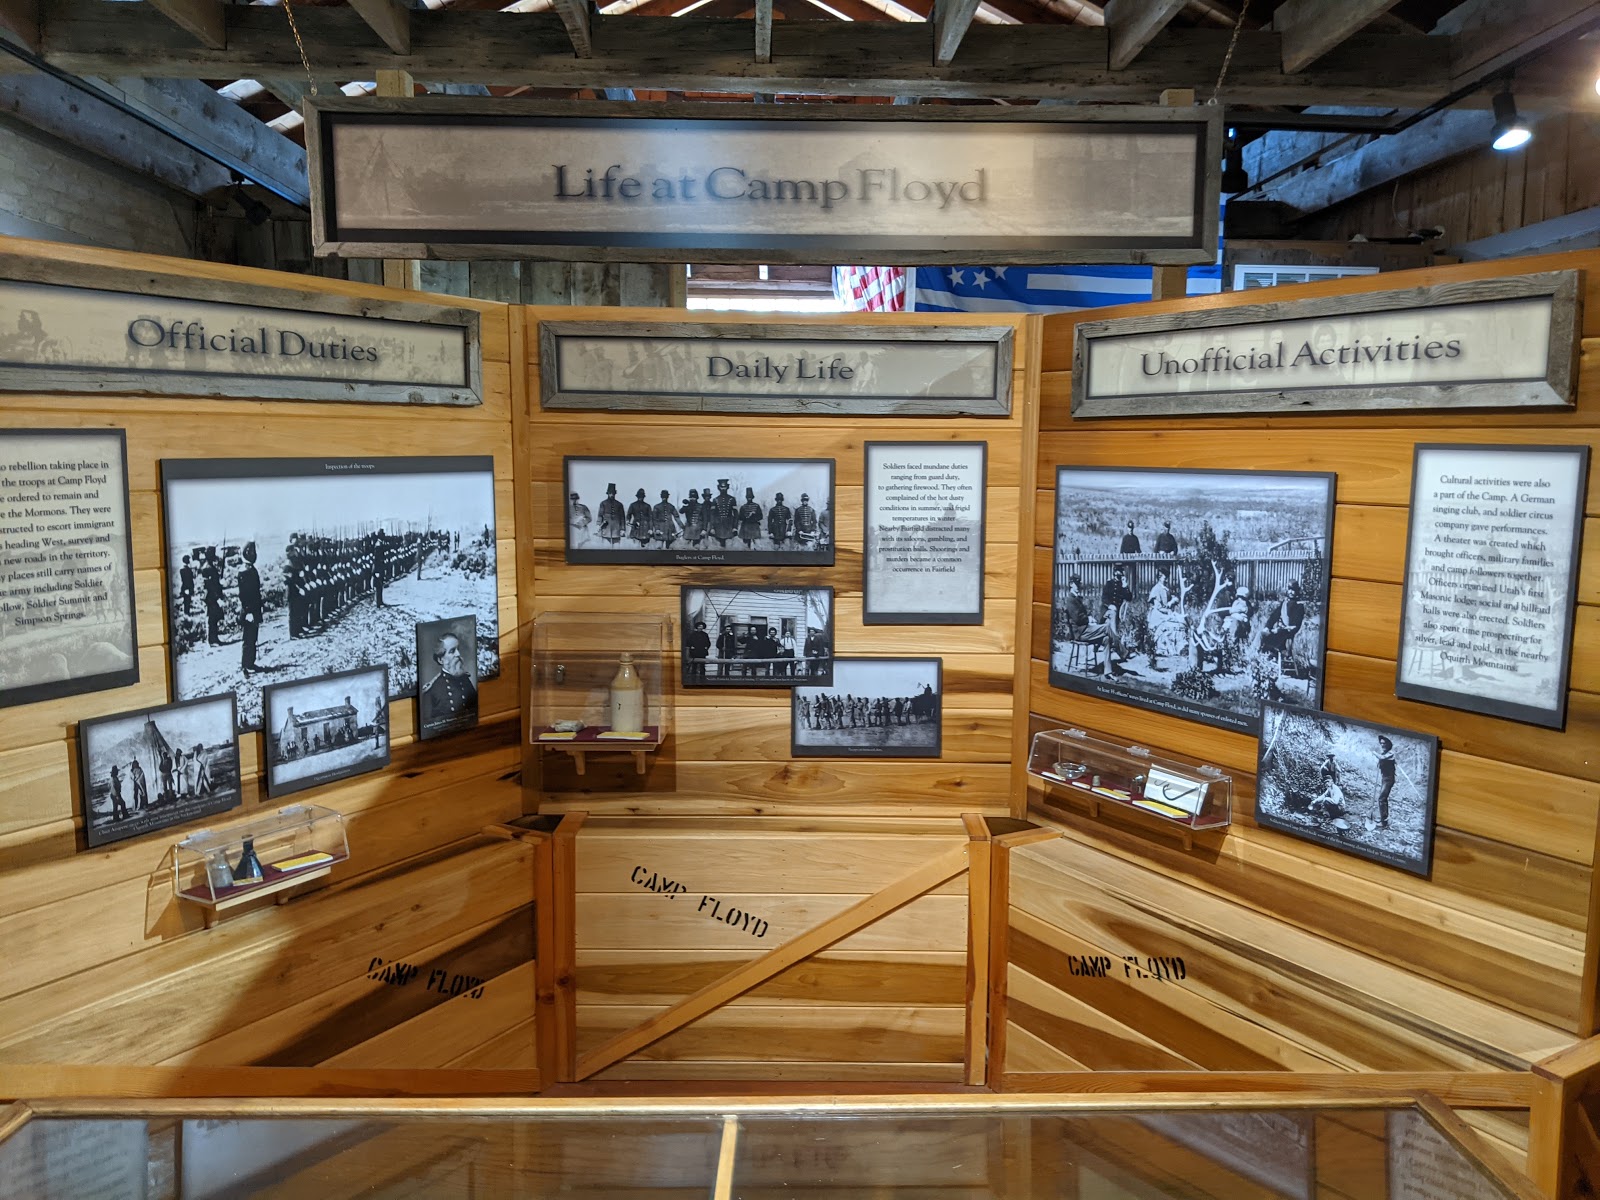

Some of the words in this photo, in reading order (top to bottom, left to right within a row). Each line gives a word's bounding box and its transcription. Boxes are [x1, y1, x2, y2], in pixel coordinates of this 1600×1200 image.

[551, 164, 642, 199] Life
[651, 174, 697, 200] at
[705, 166, 848, 209] Camp
[857, 167, 988, 209] Floyd
[127, 318, 270, 355] Official
[277, 329, 378, 361] Duties
[1140, 342, 1285, 376] Unofficial
[1290, 335, 1462, 368] Activities
[706, 356, 789, 383] Daily
[795, 358, 854, 379] Life
[9, 461, 47, 470] rebellion
[49, 460, 75, 471] taking
[77, 460, 98, 471] place
[2, 477, 16, 486] the
[18, 478, 45, 487] troops
[57, 476, 82, 486] Camp
[84, 475, 106, 486] Floyd
[891, 473, 912, 481] ranging
[1440, 474, 1472, 484] Cultural
[1474, 476, 1510, 486] activities
[1533, 478, 1550, 488] also
[7, 492, 40, 502] ordered
[53, 490, 82, 500] remain
[84, 490, 98, 499] and
[886, 494, 918, 502] complained
[949, 494, 964, 502] dusty
[1439, 491, 1454, 501] part
[1456, 490, 1464, 499] of
[1466, 490, 1479, 500] the
[1510, 492, 1518, 502] A
[1520, 493, 1555, 504] German
[8, 508, 22, 517] the
[70, 506, 90, 516] They
[955, 504, 970, 512] frigid
[1432, 504, 1459, 517] singing
[1482, 507, 1497, 516] and
[1499, 508, 1526, 518] soldier
[1528, 509, 1553, 519] circus
[35, 524, 44, 532] to
[46, 522, 71, 531] escort
[73, 519, 114, 530] immigrant
[1435, 522, 1468, 532] company
[1470, 524, 1489, 533] gave
[5, 538, 39, 549] heading
[68, 538, 92, 546] survey
[95, 533, 110, 543] and
[1434, 532, 1441, 542] A
[1443, 533, 1470, 544] theater
[1488, 539, 1518, 548] created
[1520, 540, 1545, 550] which
[24, 553, 46, 563] roads
[59, 551, 72, 561] the
[1425, 547, 1453, 560] brought
[1488, 553, 1519, 566] military
[1521, 555, 1554, 567] families
[8, 570, 34, 582] places
[36, 567, 52, 577] still
[54, 568, 74, 577] carry
[77, 566, 102, 574] names
[1431, 563, 1445, 572] and
[1446, 567, 1467, 577] camp
[1469, 565, 1504, 578] followers
[10, 588, 31, 596] army
[33, 581, 72, 593] including
[74, 578, 102, 589] Soldier
[1429, 575, 1460, 588] Officers
[1461, 581, 1497, 592] organized
[1527, 586, 1544, 597] first
[26, 598, 56, 609] Soldier
[58, 593, 90, 606] Summit
[92, 591, 108, 602] and
[1421, 589, 1451, 602] Masonic
[1479, 598, 1501, 608] social
[1503, 600, 1519, 610] and
[1520, 601, 1550, 614] billiard
[15, 616, 52, 626] Simpson
[1423, 604, 1440, 615] halls
[1442, 610, 1459, 618] were
[1462, 610, 1476, 620] also
[1512, 615, 1545, 628] Soldiers
[1424, 620, 1437, 630] also
[1439, 625, 1459, 634] spent
[1462, 625, 1479, 636] time
[1481, 630, 1528, 645] prospecting
[1530, 633, 1542, 644] for
[1439, 636, 1454, 647] lead
[1456, 640, 1471, 649] and
[1494, 644, 1503, 654] in
[1504, 645, 1518, 656] the
[1520, 650, 1548, 663] nearby
[1440, 651, 1470, 664] Oquirrh
[631, 866, 687, 900] CAMP
[698, 895, 769, 937] FLOYD
[1068, 955, 1111, 977] CAMP
[1123, 956, 1186, 980] FLOYD
[367, 957, 418, 985] CAMP
[427, 969, 485, 999] FLOYD
